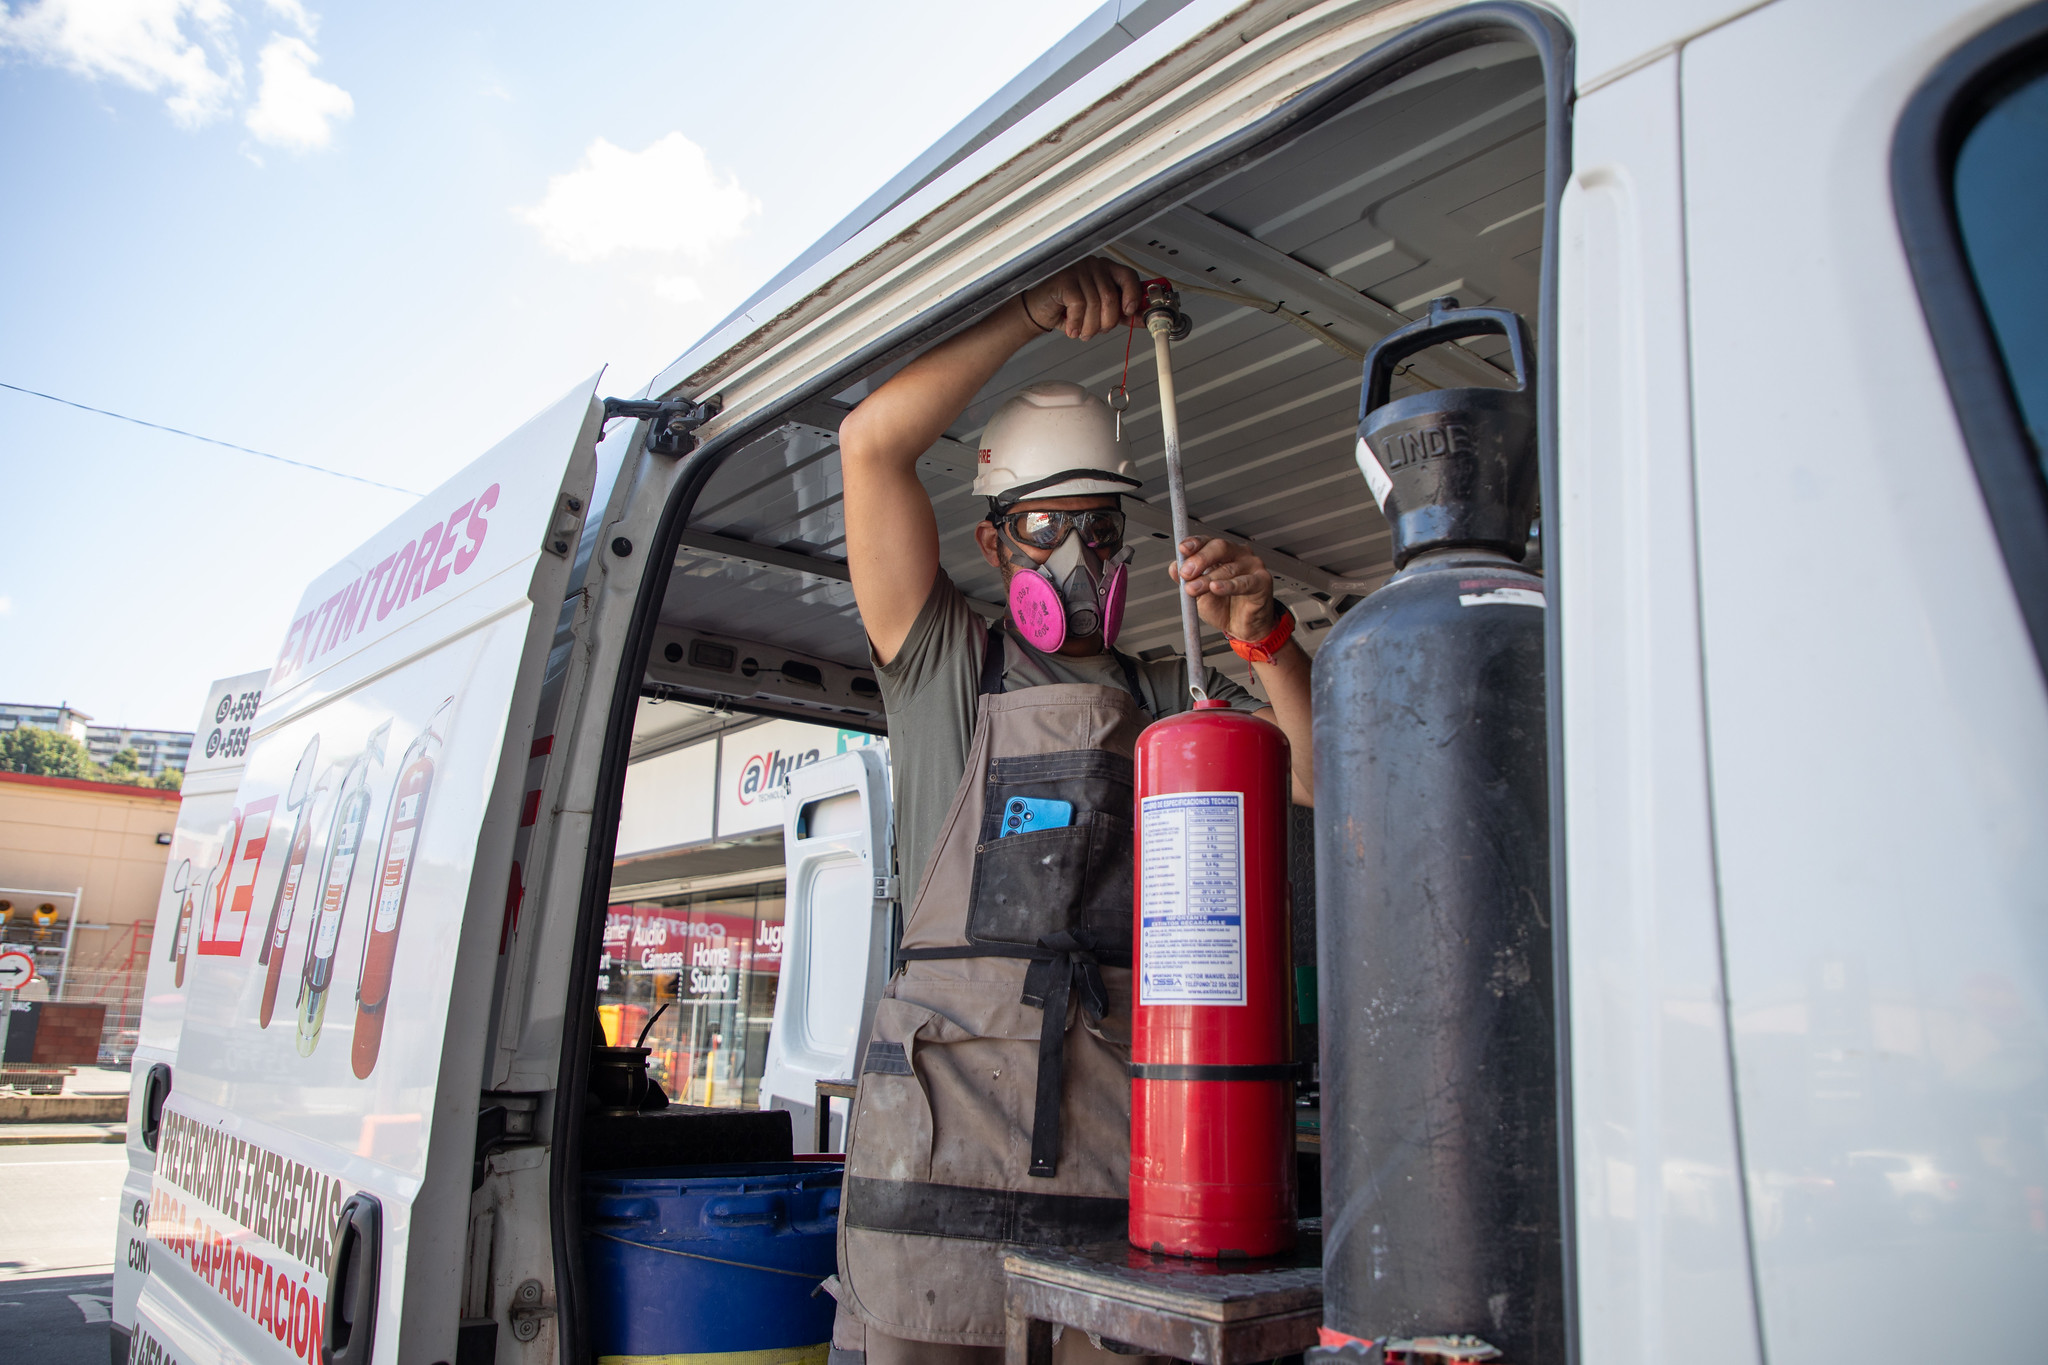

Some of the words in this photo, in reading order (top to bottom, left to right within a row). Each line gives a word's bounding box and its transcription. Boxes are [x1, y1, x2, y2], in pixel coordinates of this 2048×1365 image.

[1384, 424, 1469, 469] LINDE
[271, 482, 500, 686] EXTINTORES
[230, 690, 262, 722] +569
[219, 726, 251, 758] +569
[632, 920, 667, 947] Audio
[641, 948, 683, 969] Cámaras
[692, 943, 731, 967] Home
[690, 966, 730, 993] Studio
[160, 1109, 229, 1212] PREVENCIÓN
[222, 1135, 245, 1222] DE
[239, 1143, 342, 1279] EMERGECIAS
[128, 1237, 150, 1275] CON
[148, 1187, 327, 1365] ARGA-CAPACITACIÓN
